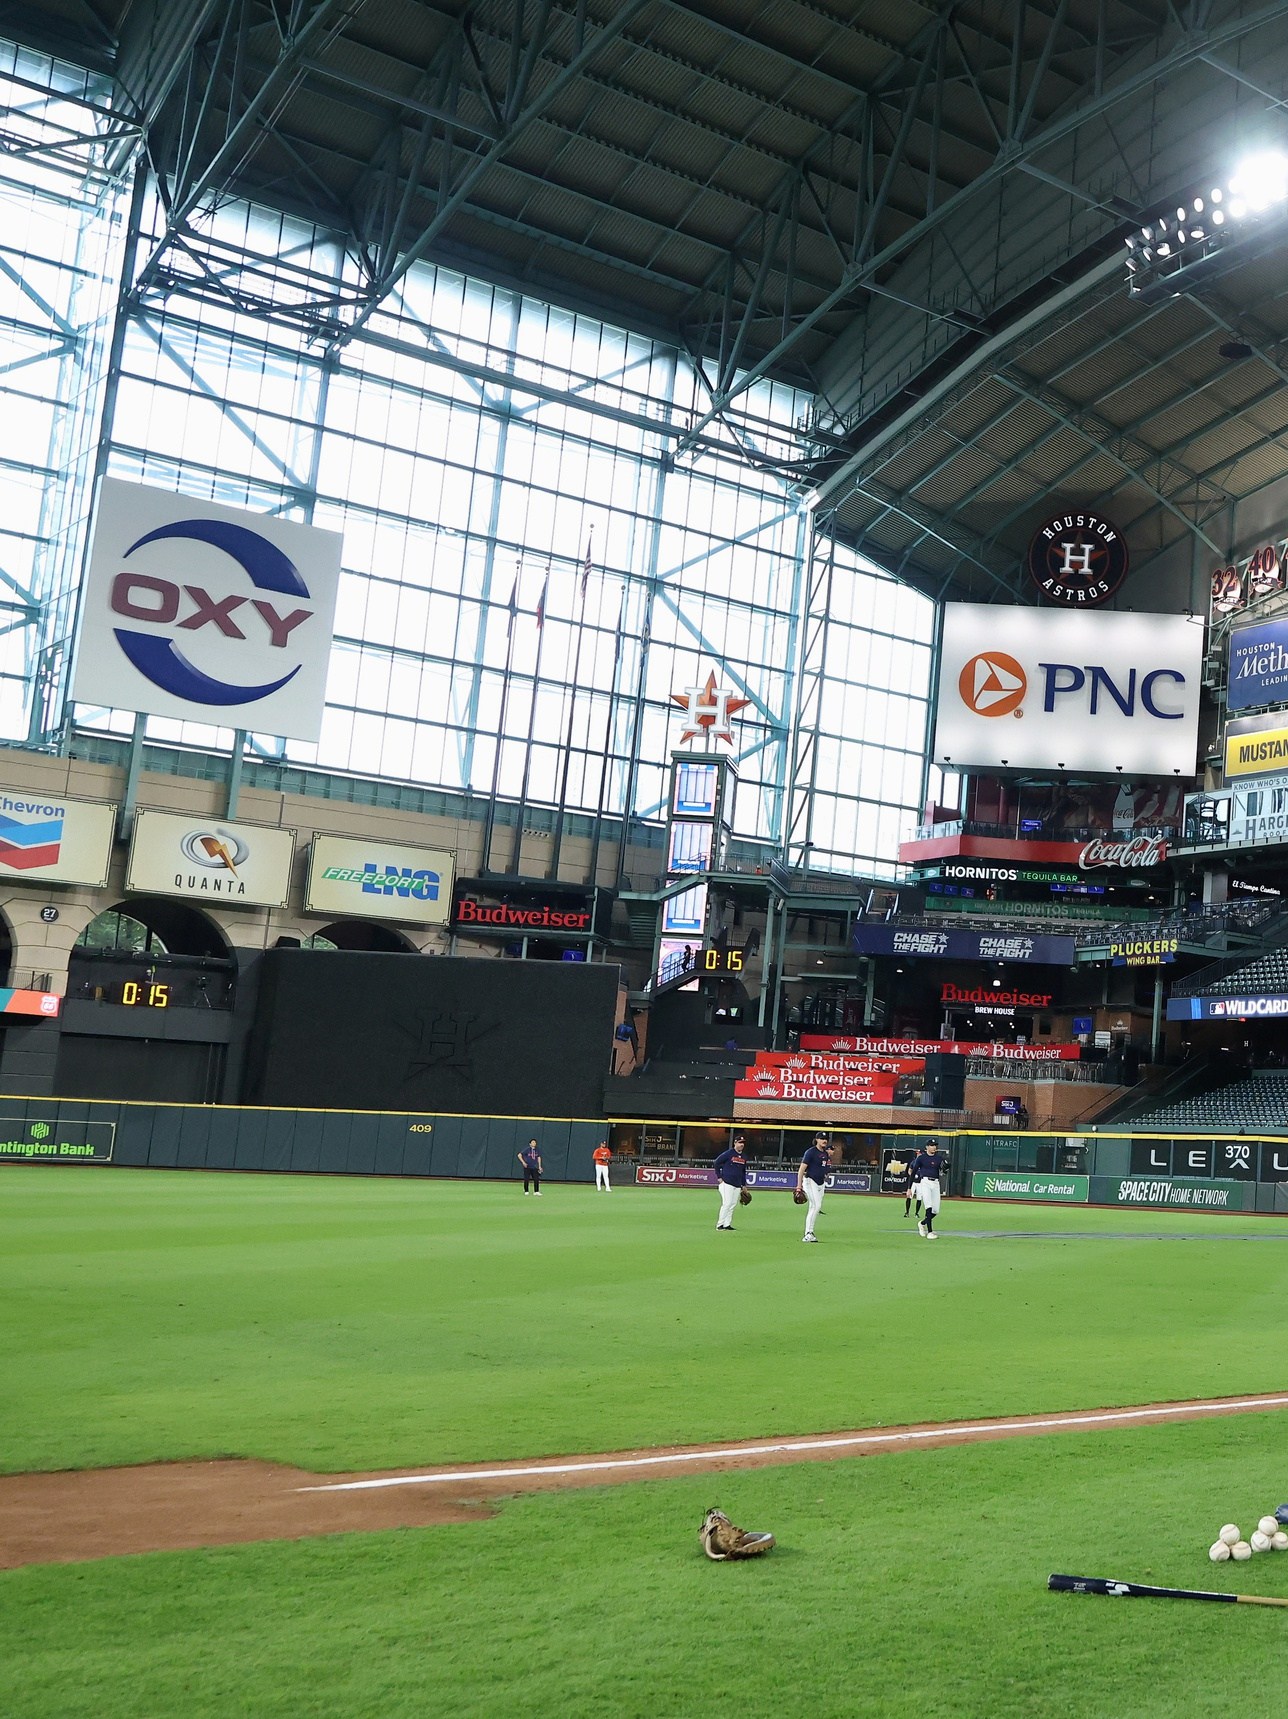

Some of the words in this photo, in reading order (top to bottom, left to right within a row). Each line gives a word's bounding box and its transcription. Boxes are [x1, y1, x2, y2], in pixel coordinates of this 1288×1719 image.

[1042, 515, 1117, 542] HOUSTON
[1060, 542, 1095, 574] H
[1249, 547, 1275, 575] 40
[1042, 578, 1109, 601] ASTROS
[1212, 566, 1237, 596] 32
[110, 572, 315, 648] OXY
[1236, 642, 1276, 657] HOUSTON
[1038, 662, 1186, 720] PNC
[681, 686, 734, 733] H
[1233, 782, 1255, 791] KNOW
[1257, 779, 1280, 788] WHO'S
[0, 796, 65, 818] hevron
[326, 866, 426, 890] FREEPORT
[362, 863, 440, 901] LNG
[945, 865, 1017, 881] HORNITOS
[1021, 871, 1058, 881] TEQUILA
[1060, 873, 1078, 882] BAR
[174, 874, 246, 894] QUANTA
[43, 908, 56, 918] 27
[457, 900, 592, 928] Budweiser
[1005, 902, 1069, 915] HORNITOS
[893, 932, 936, 944] CHASE
[979, 937, 1023, 949] CHASE
[893, 942, 910, 950] THE
[910, 943, 947, 954] FIGHT
[979, 947, 996, 955] THE
[995, 948, 1033, 958] FIGHT
[1110, 938, 1178, 957] PLUCKERS
[705, 950, 743, 971] 0:15
[1126, 956, 1145, 966] WING
[1146, 955, 1161, 965] BAR
[123, 982, 168, 1008] 0:15
[940, 982, 1052, 1007] Budweiser
[974, 1006, 993, 1015] BREW
[994, 1007, 1015, 1017] HOUSE
[855, 1037, 941, 1054] Budweiser
[991, 1044, 1062, 1060] Budweiser
[810, 1055, 900, 1074] Budweiser
[779, 1069, 872, 1086] Budweiser
[782, 1083, 875, 1102] Budweiser
[409, 1123, 432, 1134] 409
[60, 1143, 95, 1156] Bank
[1225, 1145, 1250, 1159] 370
[678, 1172, 708, 1181] Marketing
[759, 1175, 787, 1184] Marketing
[837, 1178, 866, 1187] Marketing
[994, 1179, 1030, 1192] National
[1034, 1183, 1048, 1193] Car
[1048, 1184, 1075, 1195] Rental
[1118, 1181, 1150, 1202] SPACE
[1149, 1182, 1172, 1202] CITY
[1171, 1188, 1192, 1203] HOME
[1192, 1189, 1229, 1206] NETWORK
